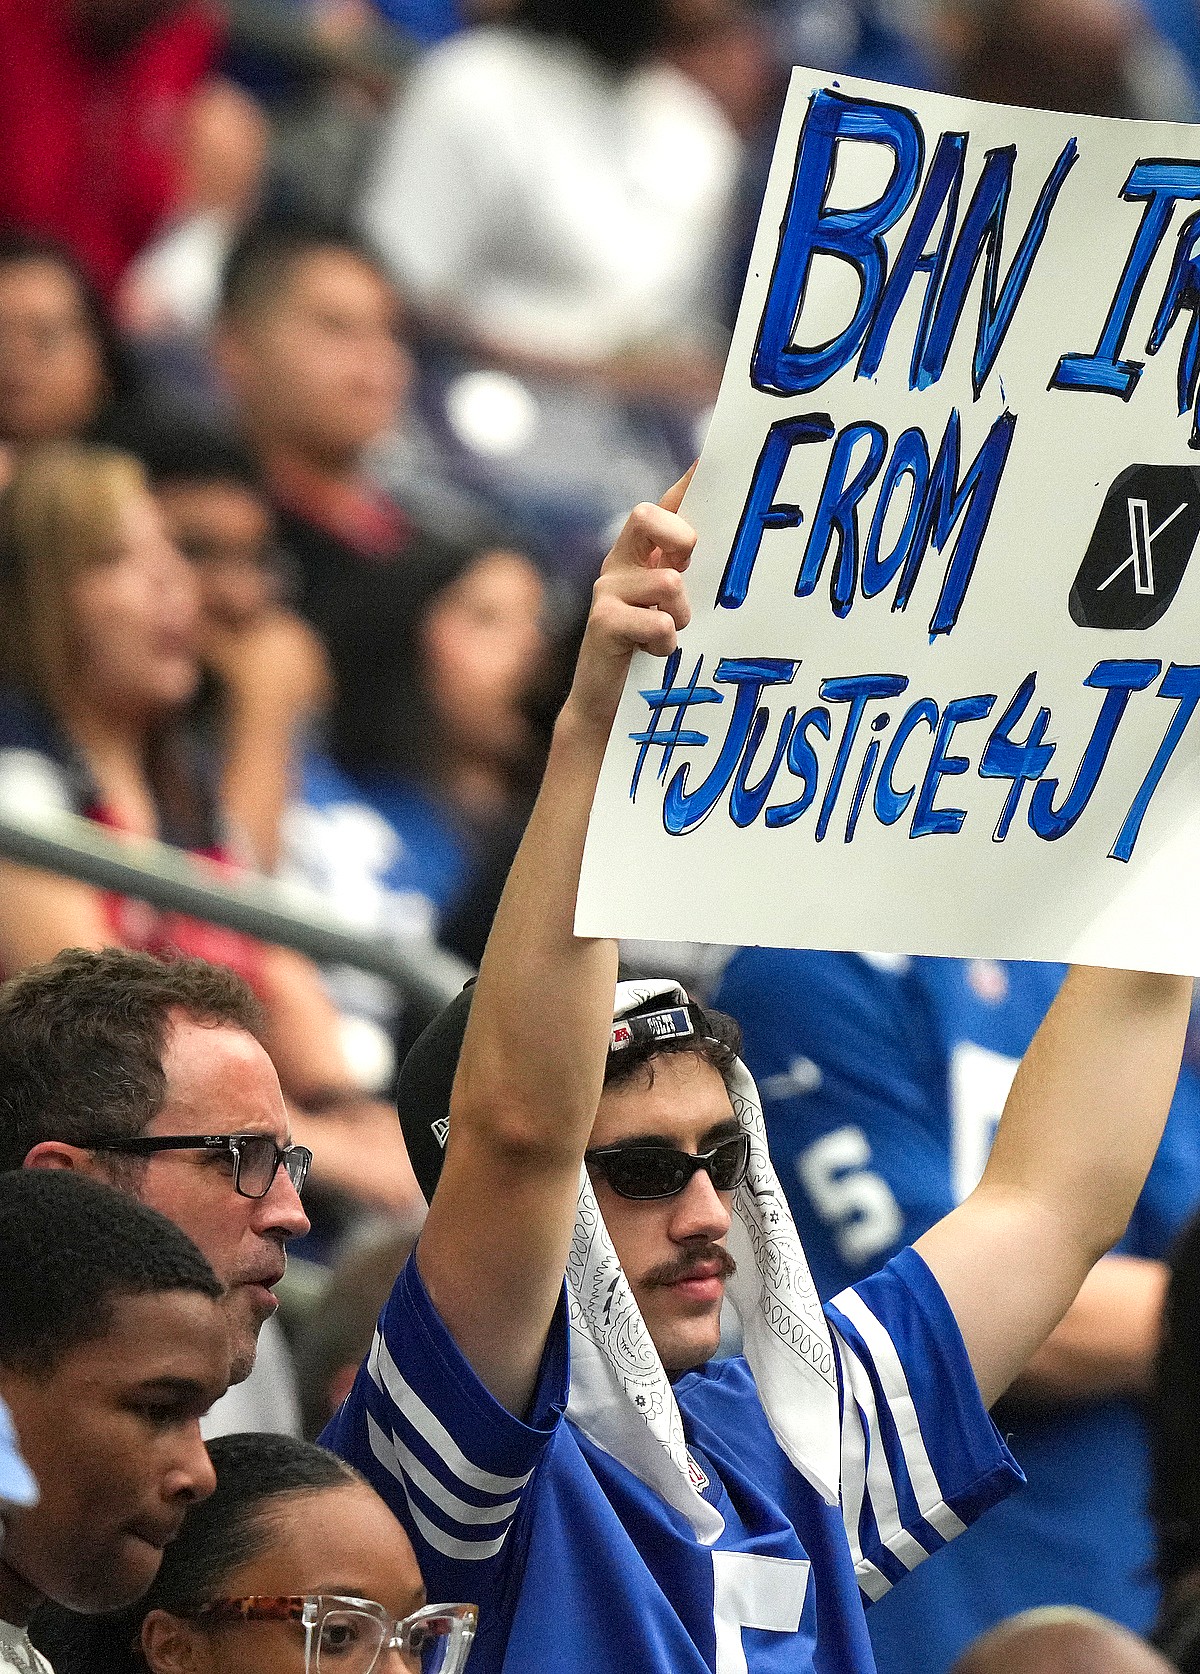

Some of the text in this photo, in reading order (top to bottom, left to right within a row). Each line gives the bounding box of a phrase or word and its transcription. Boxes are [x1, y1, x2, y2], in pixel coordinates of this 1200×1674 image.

[749, 88, 1080, 402] BAN
[714, 410, 1018, 643] FROM
[799, 1125, 901, 1264] 5
